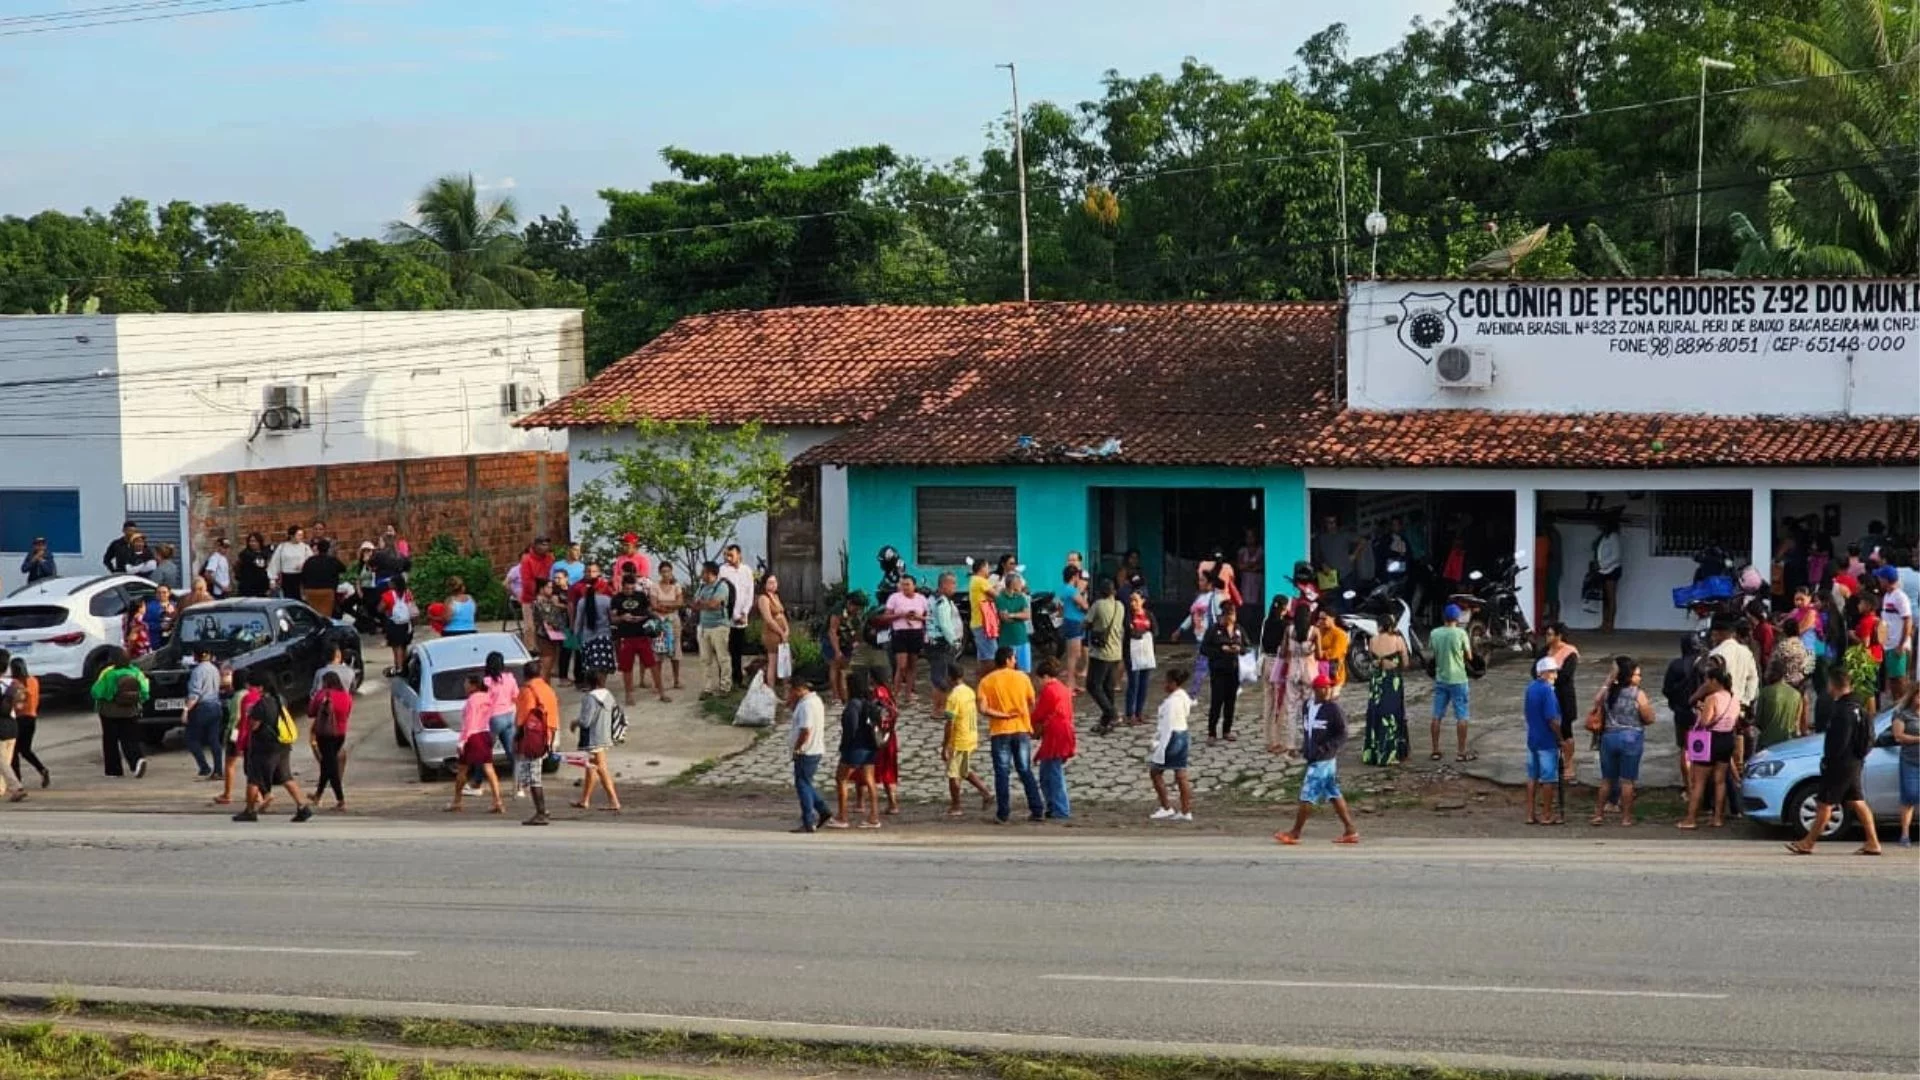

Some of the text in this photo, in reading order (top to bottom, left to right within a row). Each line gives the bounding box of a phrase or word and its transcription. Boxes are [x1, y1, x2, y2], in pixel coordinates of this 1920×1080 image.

[1458, 283, 1562, 318] COLÔNIA
[1570, 287, 1599, 317] DE
[1606, 285, 1756, 316] PESCADORES
[1816, 284, 1847, 313] DO
[1476, 321, 1525, 335] AVENIDA
[1527, 321, 1572, 335] BRASIL
[1591, 320, 1616, 335] 323
[1619, 320, 1655, 334] ZONA
[1658, 319, 1700, 334] RURAL
[1731, 319, 1746, 333] DE
[1749, 318, 1784, 333] BAIXO
